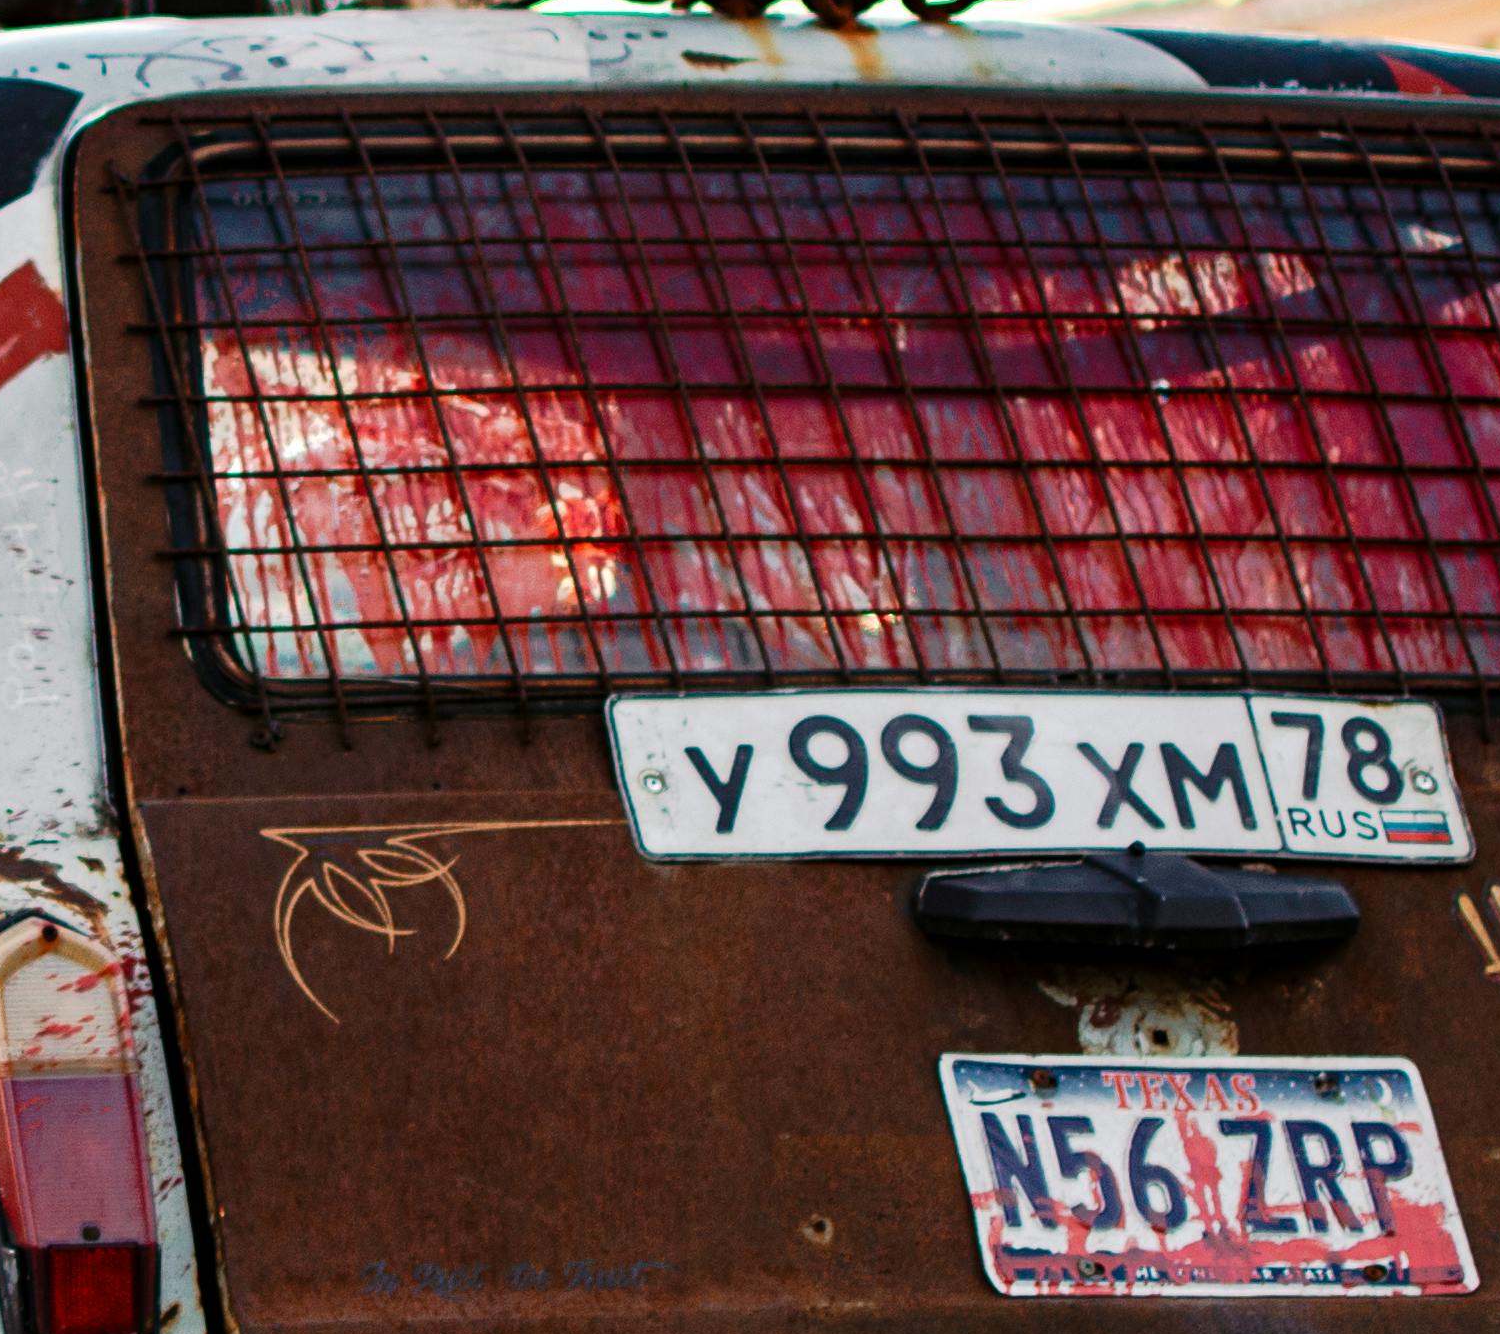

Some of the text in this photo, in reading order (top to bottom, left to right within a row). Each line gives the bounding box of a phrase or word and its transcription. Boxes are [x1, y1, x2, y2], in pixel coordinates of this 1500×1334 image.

[1270, 710, 1404, 806] 78
[1289, 809, 1379, 841] RUS
[1102, 1070, 1262, 1115] TEXAS
[981, 1112, 1414, 1238] N56 ZRP
